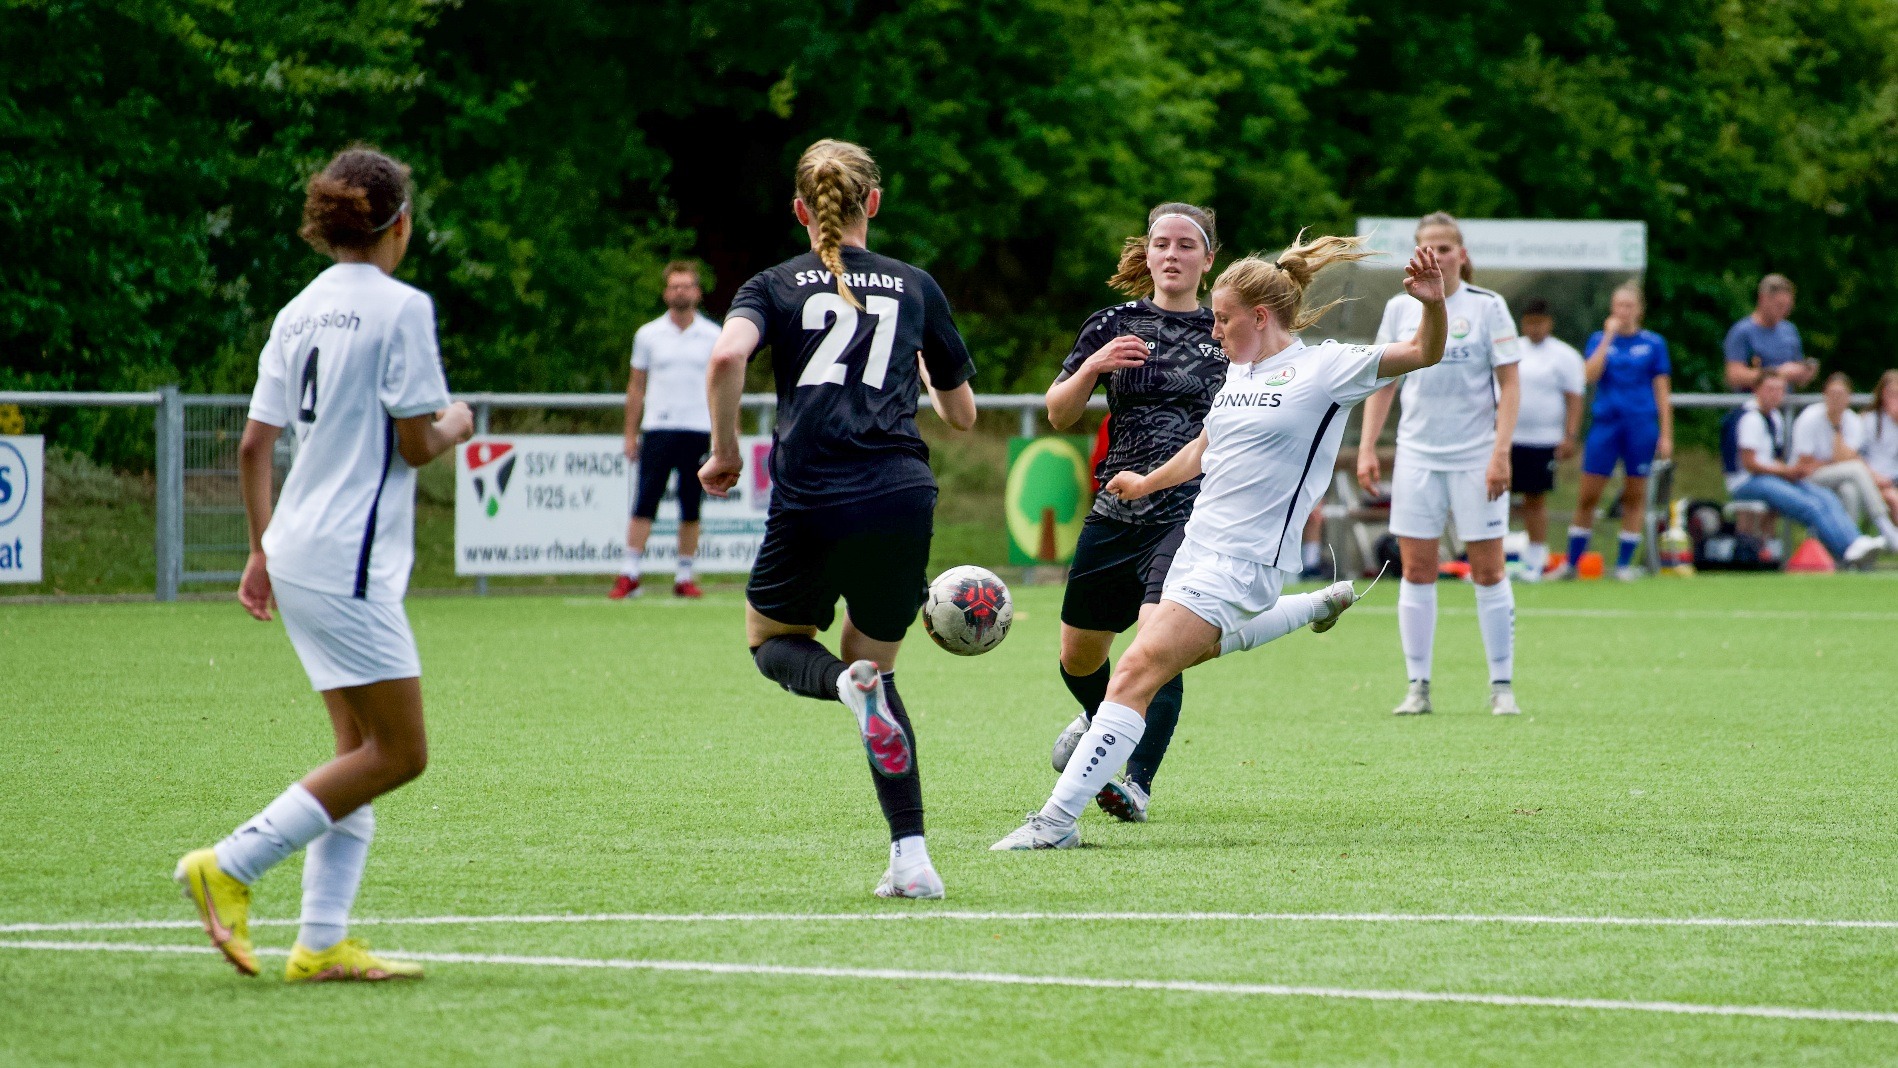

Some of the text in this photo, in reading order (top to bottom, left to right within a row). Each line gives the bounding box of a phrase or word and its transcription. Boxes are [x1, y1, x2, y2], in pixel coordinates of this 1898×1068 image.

[795, 269, 905, 293] SSV RHADE
[796, 292, 900, 390] 27
[525, 452, 624, 477] SSV RHADE
[526, 484, 565, 510] 1925
